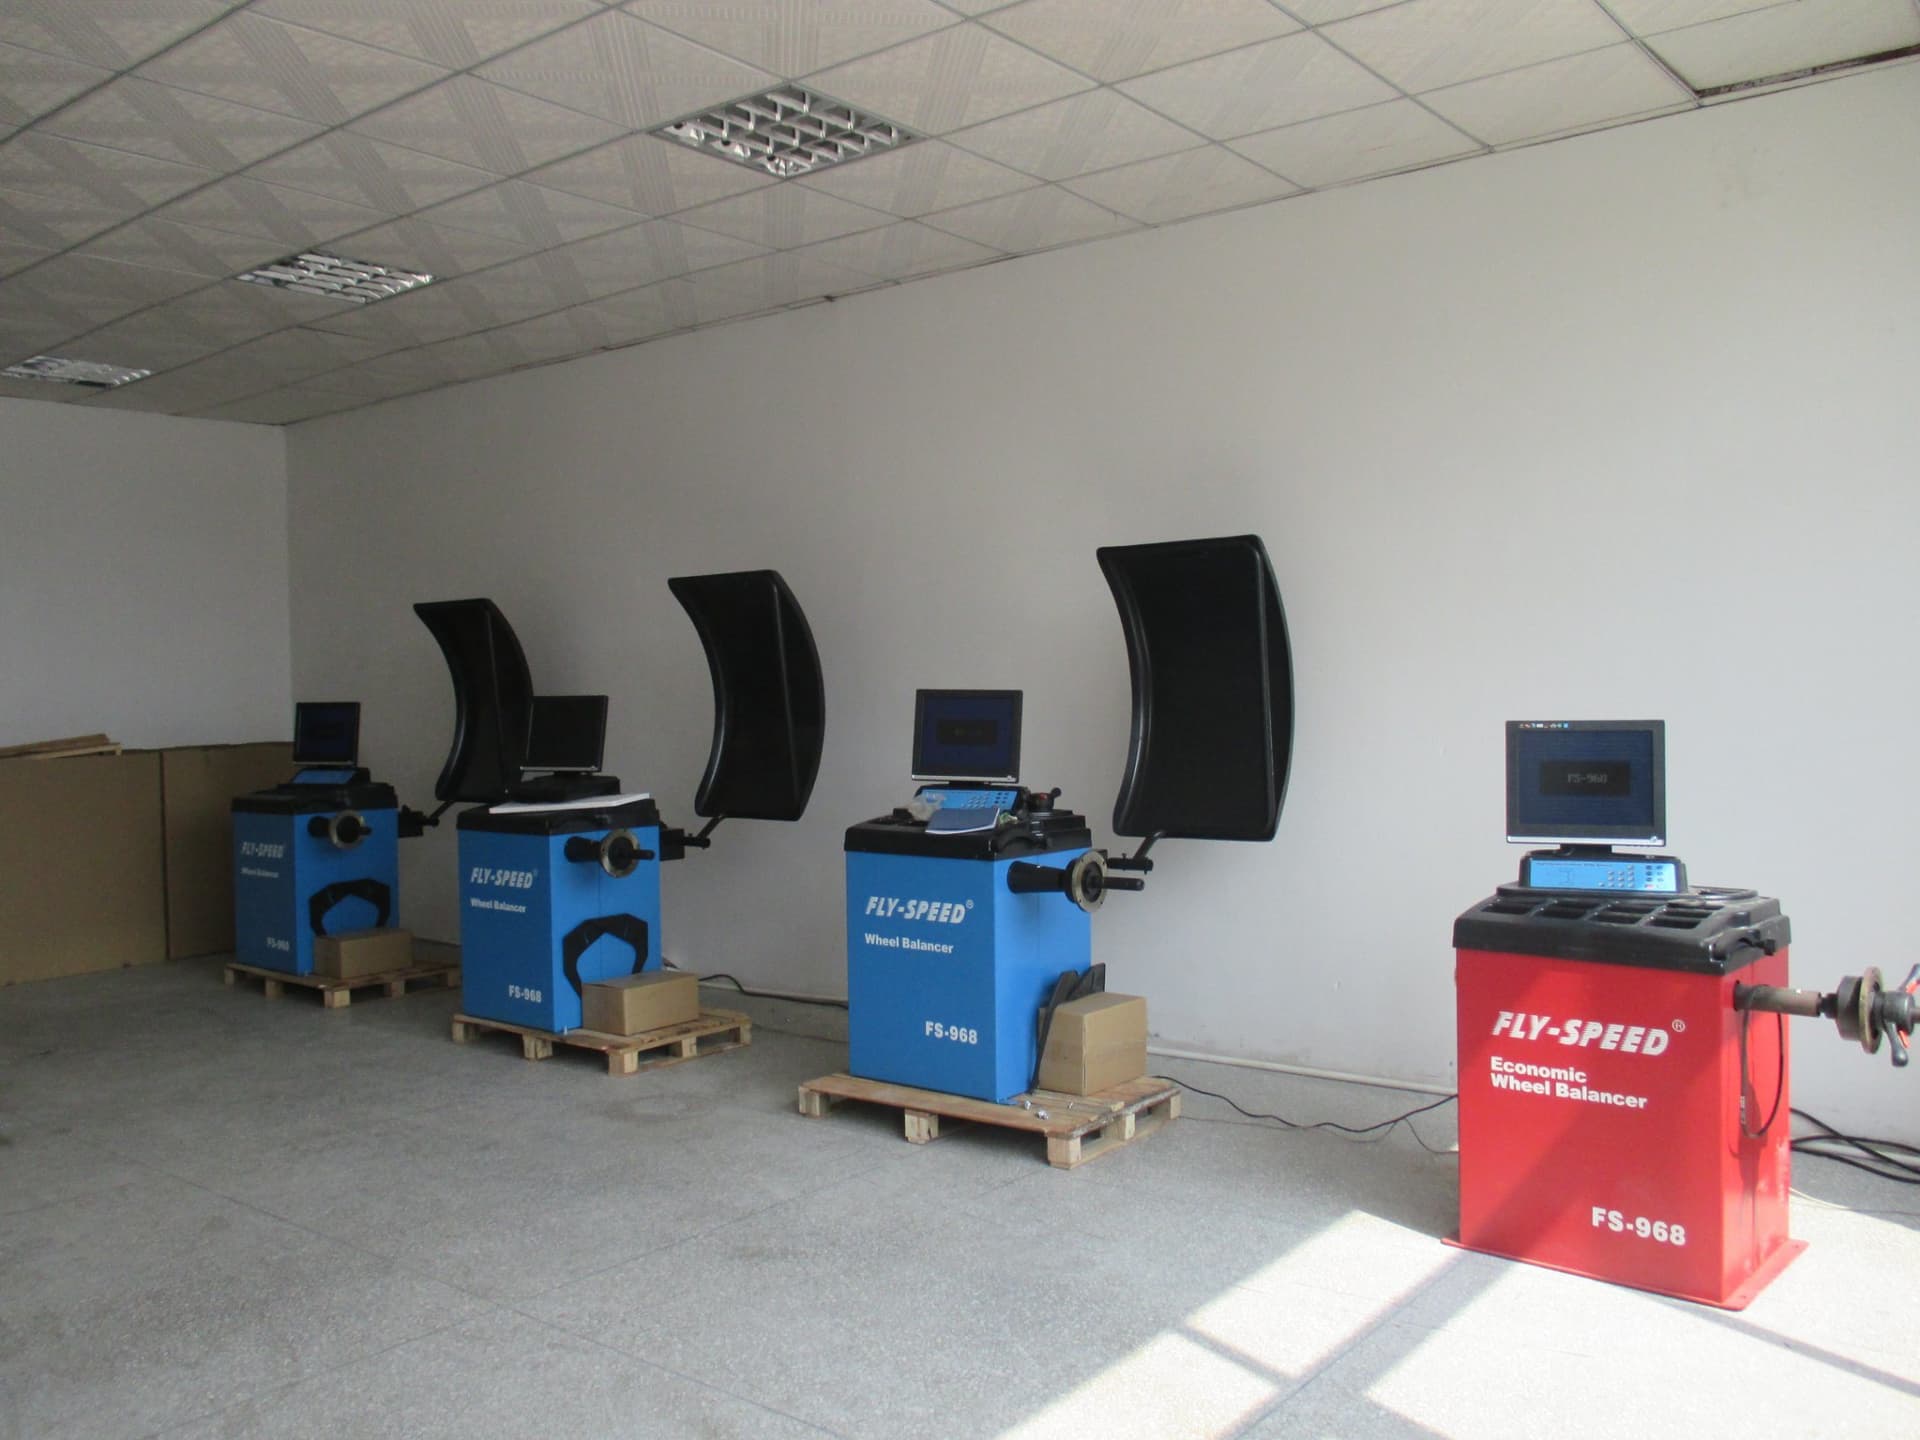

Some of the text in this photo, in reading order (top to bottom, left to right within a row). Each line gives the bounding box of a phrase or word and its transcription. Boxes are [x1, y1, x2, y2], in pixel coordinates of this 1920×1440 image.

[471, 867, 534, 889] FLY-SPEED
[865, 896, 966, 924] FLY-SPEED
[865, 933, 954, 954] Wheel Balancer
[508, 984, 542, 1003] FS-968
[925, 1020, 978, 1045] FS-968
[1491, 1011, 1669, 1056] FLY-SPEED
[1490, 1055, 1587, 1083] Economic
[1490, 1072, 1648, 1109] Wheel Balancer
[1591, 1206, 1687, 1247] FS-968
